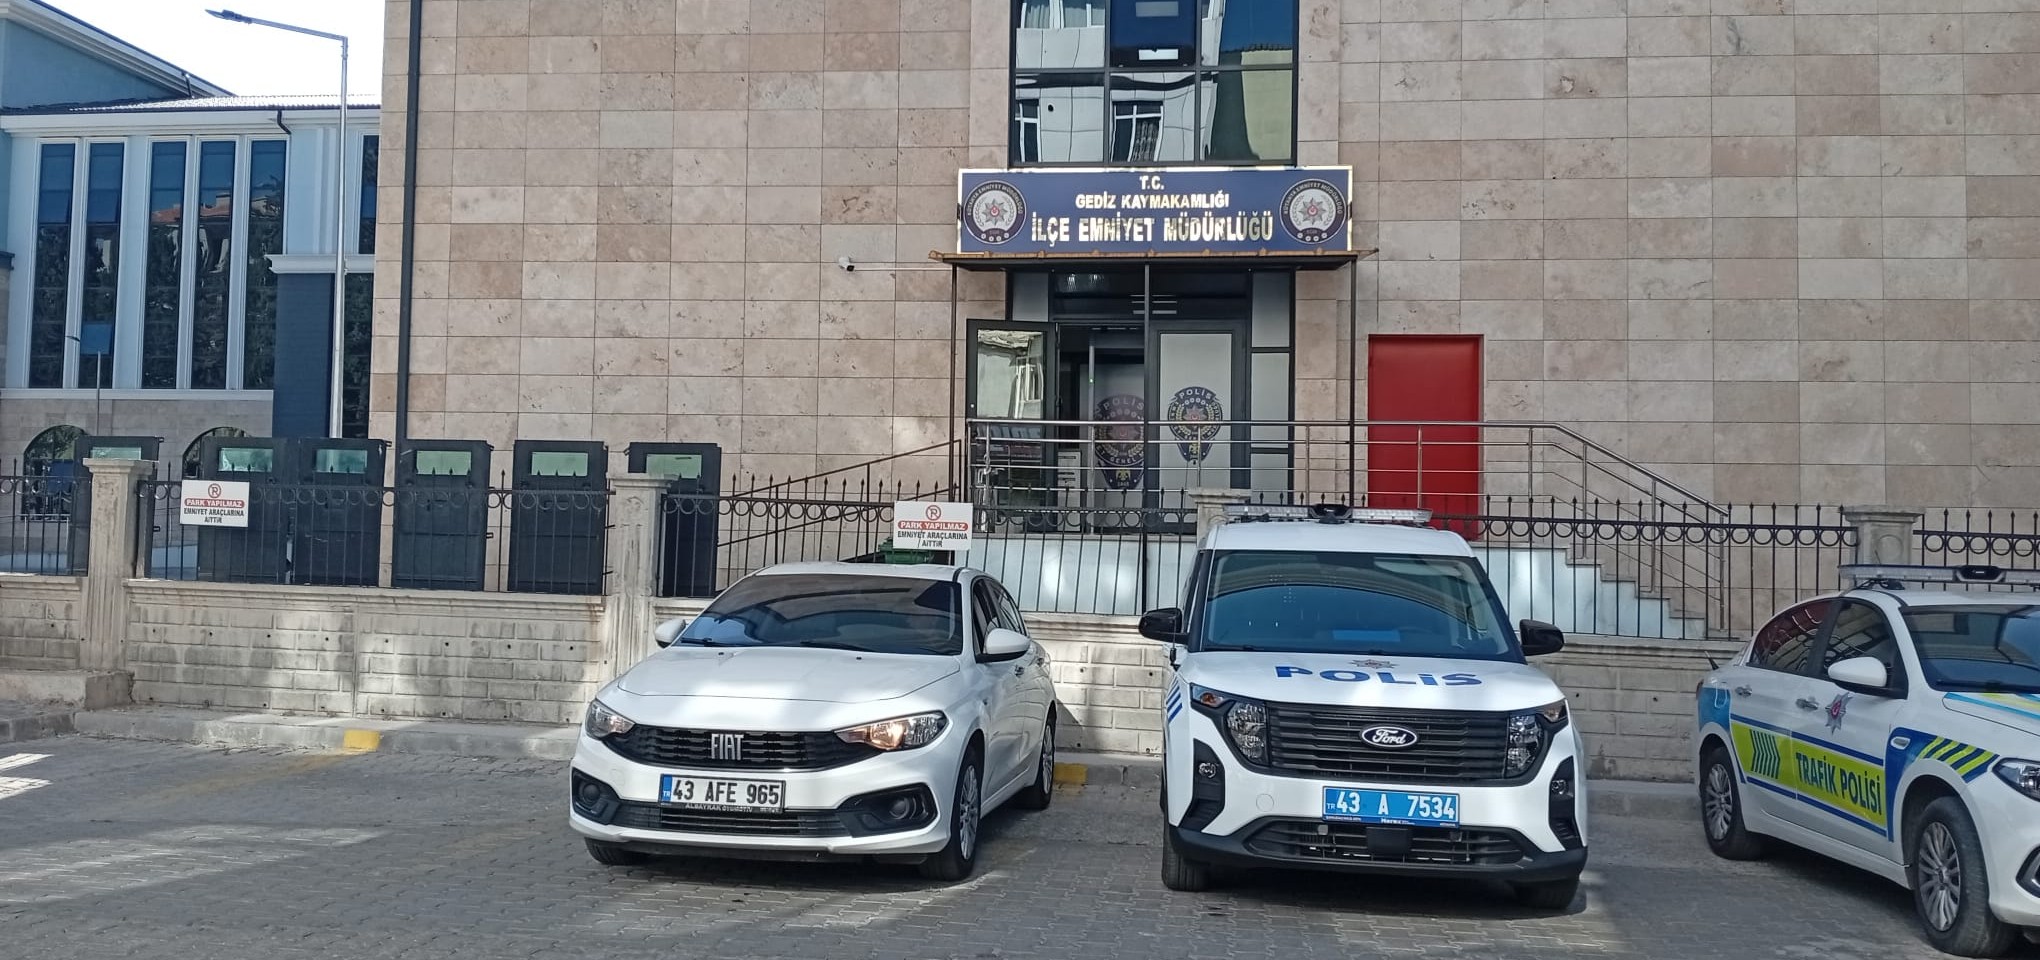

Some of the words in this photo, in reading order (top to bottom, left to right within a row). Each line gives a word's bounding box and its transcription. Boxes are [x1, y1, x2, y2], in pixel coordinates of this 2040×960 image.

[1139, 175, 1165, 190] T.C.
[1075, 191, 1117, 209] GEDİZ
[1121, 190, 1230, 209] KAYMAKAMLIĞI
[1031, 211, 1070, 247] İLÇE
[1079, 211, 1155, 242] EMNİYET
[1163, 210, 1273, 242] MÜDÜRLÜĞÜ
[186, 498, 205, 506] PARK
[207, 499, 243, 508] YAPILMAZ
[209, 508, 244, 517] ARAÇLARINA
[900, 521, 922, 529] PARK
[924, 522, 966, 531] YAPILMAZ
[927, 531, 968, 540] ARAÇLARINA
[1372, 728, 1407, 744] Ford
[711, 733, 745, 760] FIAT
[1795, 752, 1838, 797] TRAFİK
[1840, 768, 1882, 815] POLİSİ
[673, 780, 694, 800] 43
[705, 781, 738, 803] AFE
[746, 784, 780, 805] 965
[1336, 791, 1360, 813] 43
[1378, 793, 1389, 815] A
[1407, 795, 1455, 819] 7534
